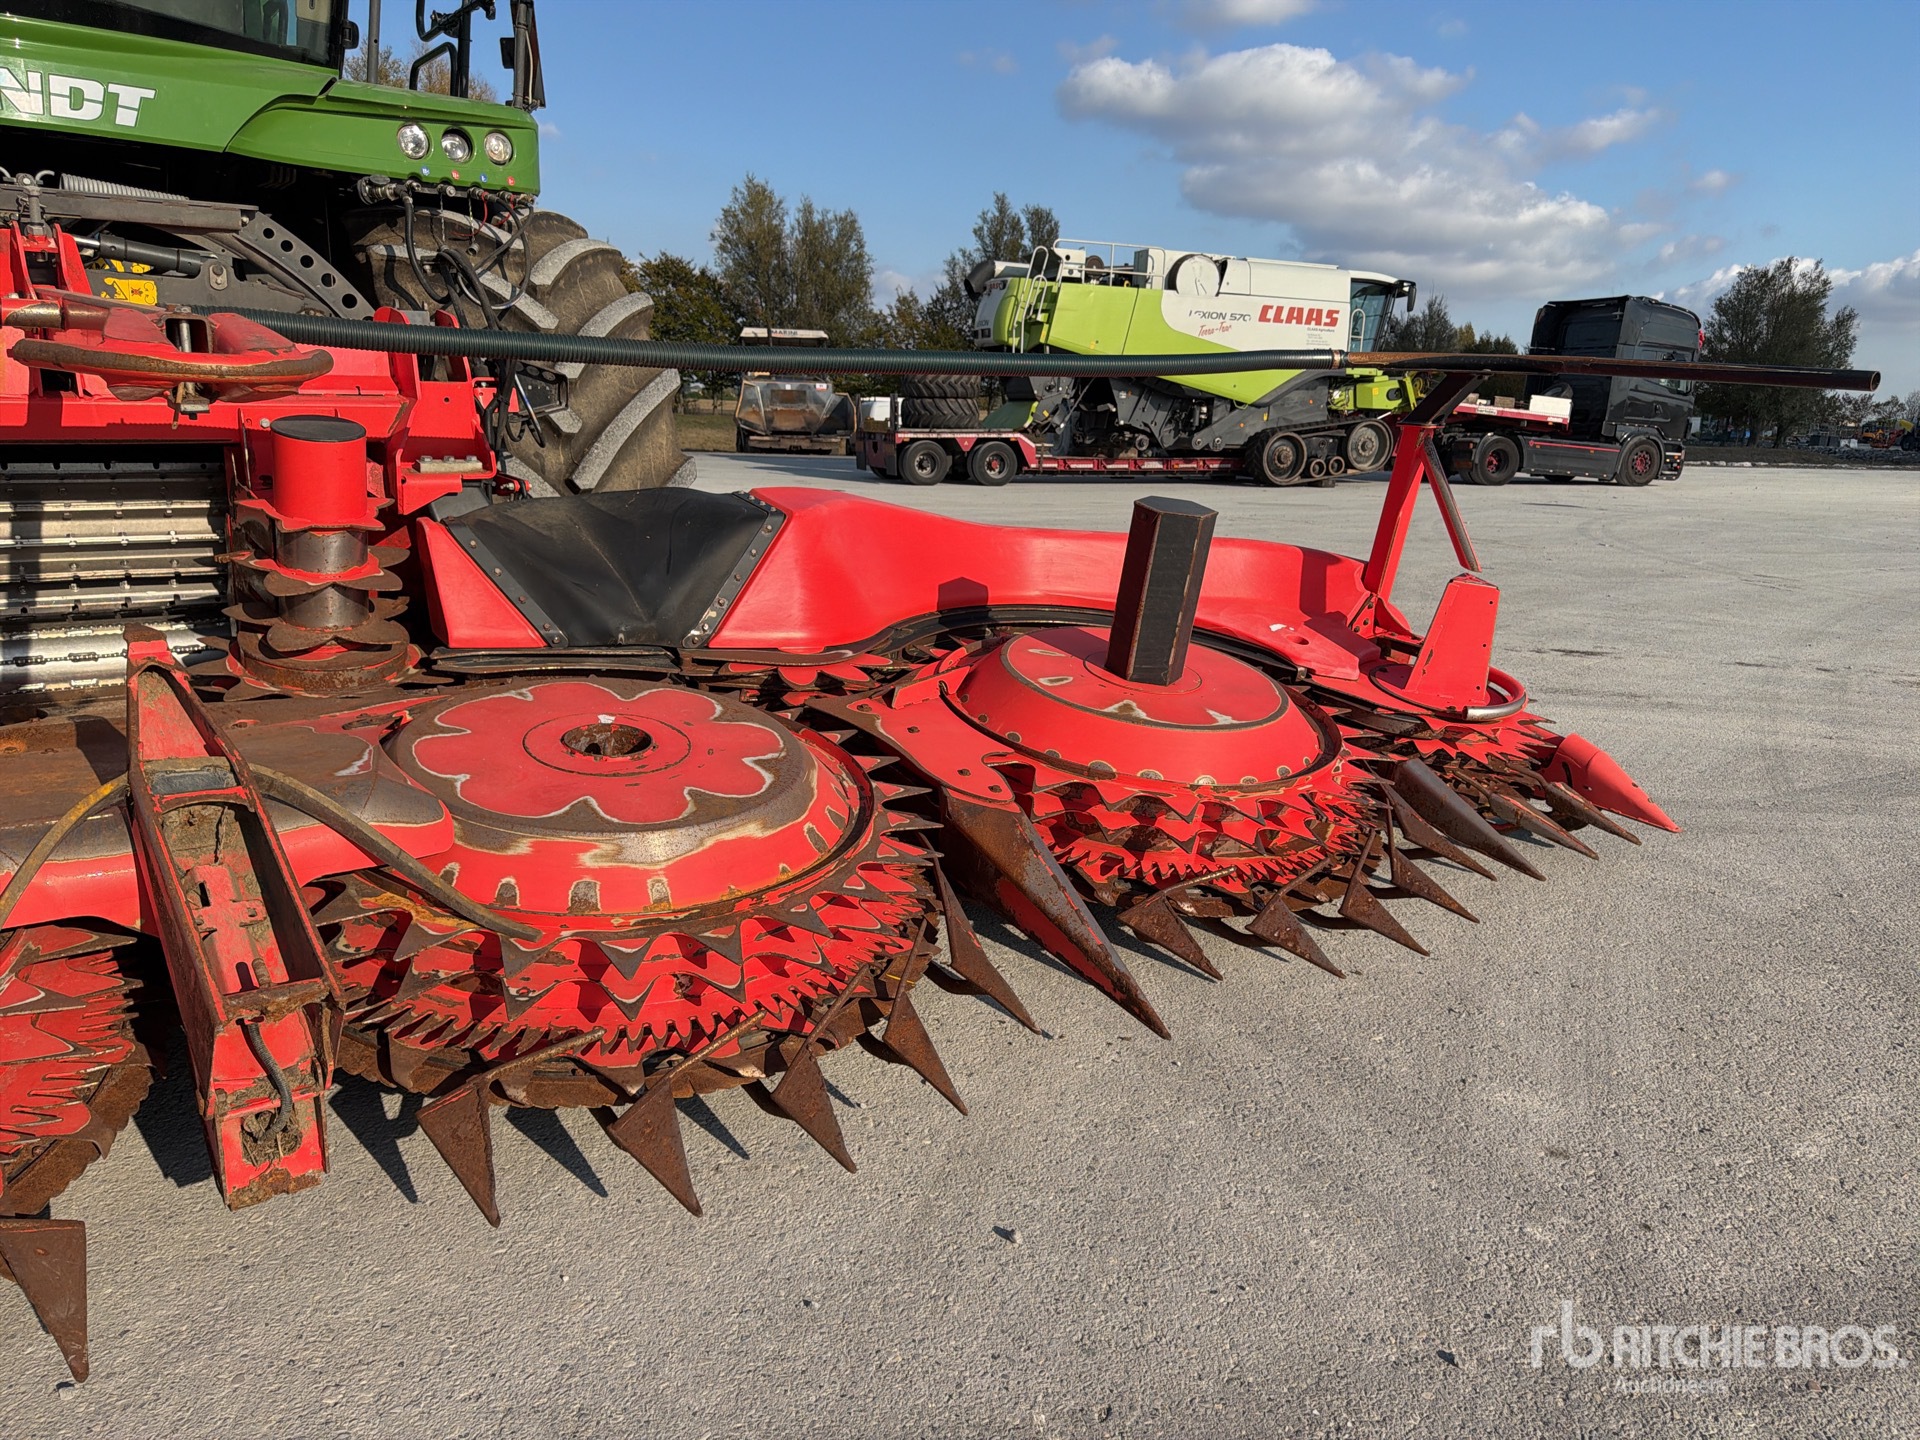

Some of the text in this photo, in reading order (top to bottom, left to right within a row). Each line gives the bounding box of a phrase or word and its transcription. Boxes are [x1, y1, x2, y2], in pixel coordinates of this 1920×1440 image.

[0, 66, 157, 127] NDT
[1229, 313, 1252, 323] 570
[1258, 304, 1340, 327] CLAAS
